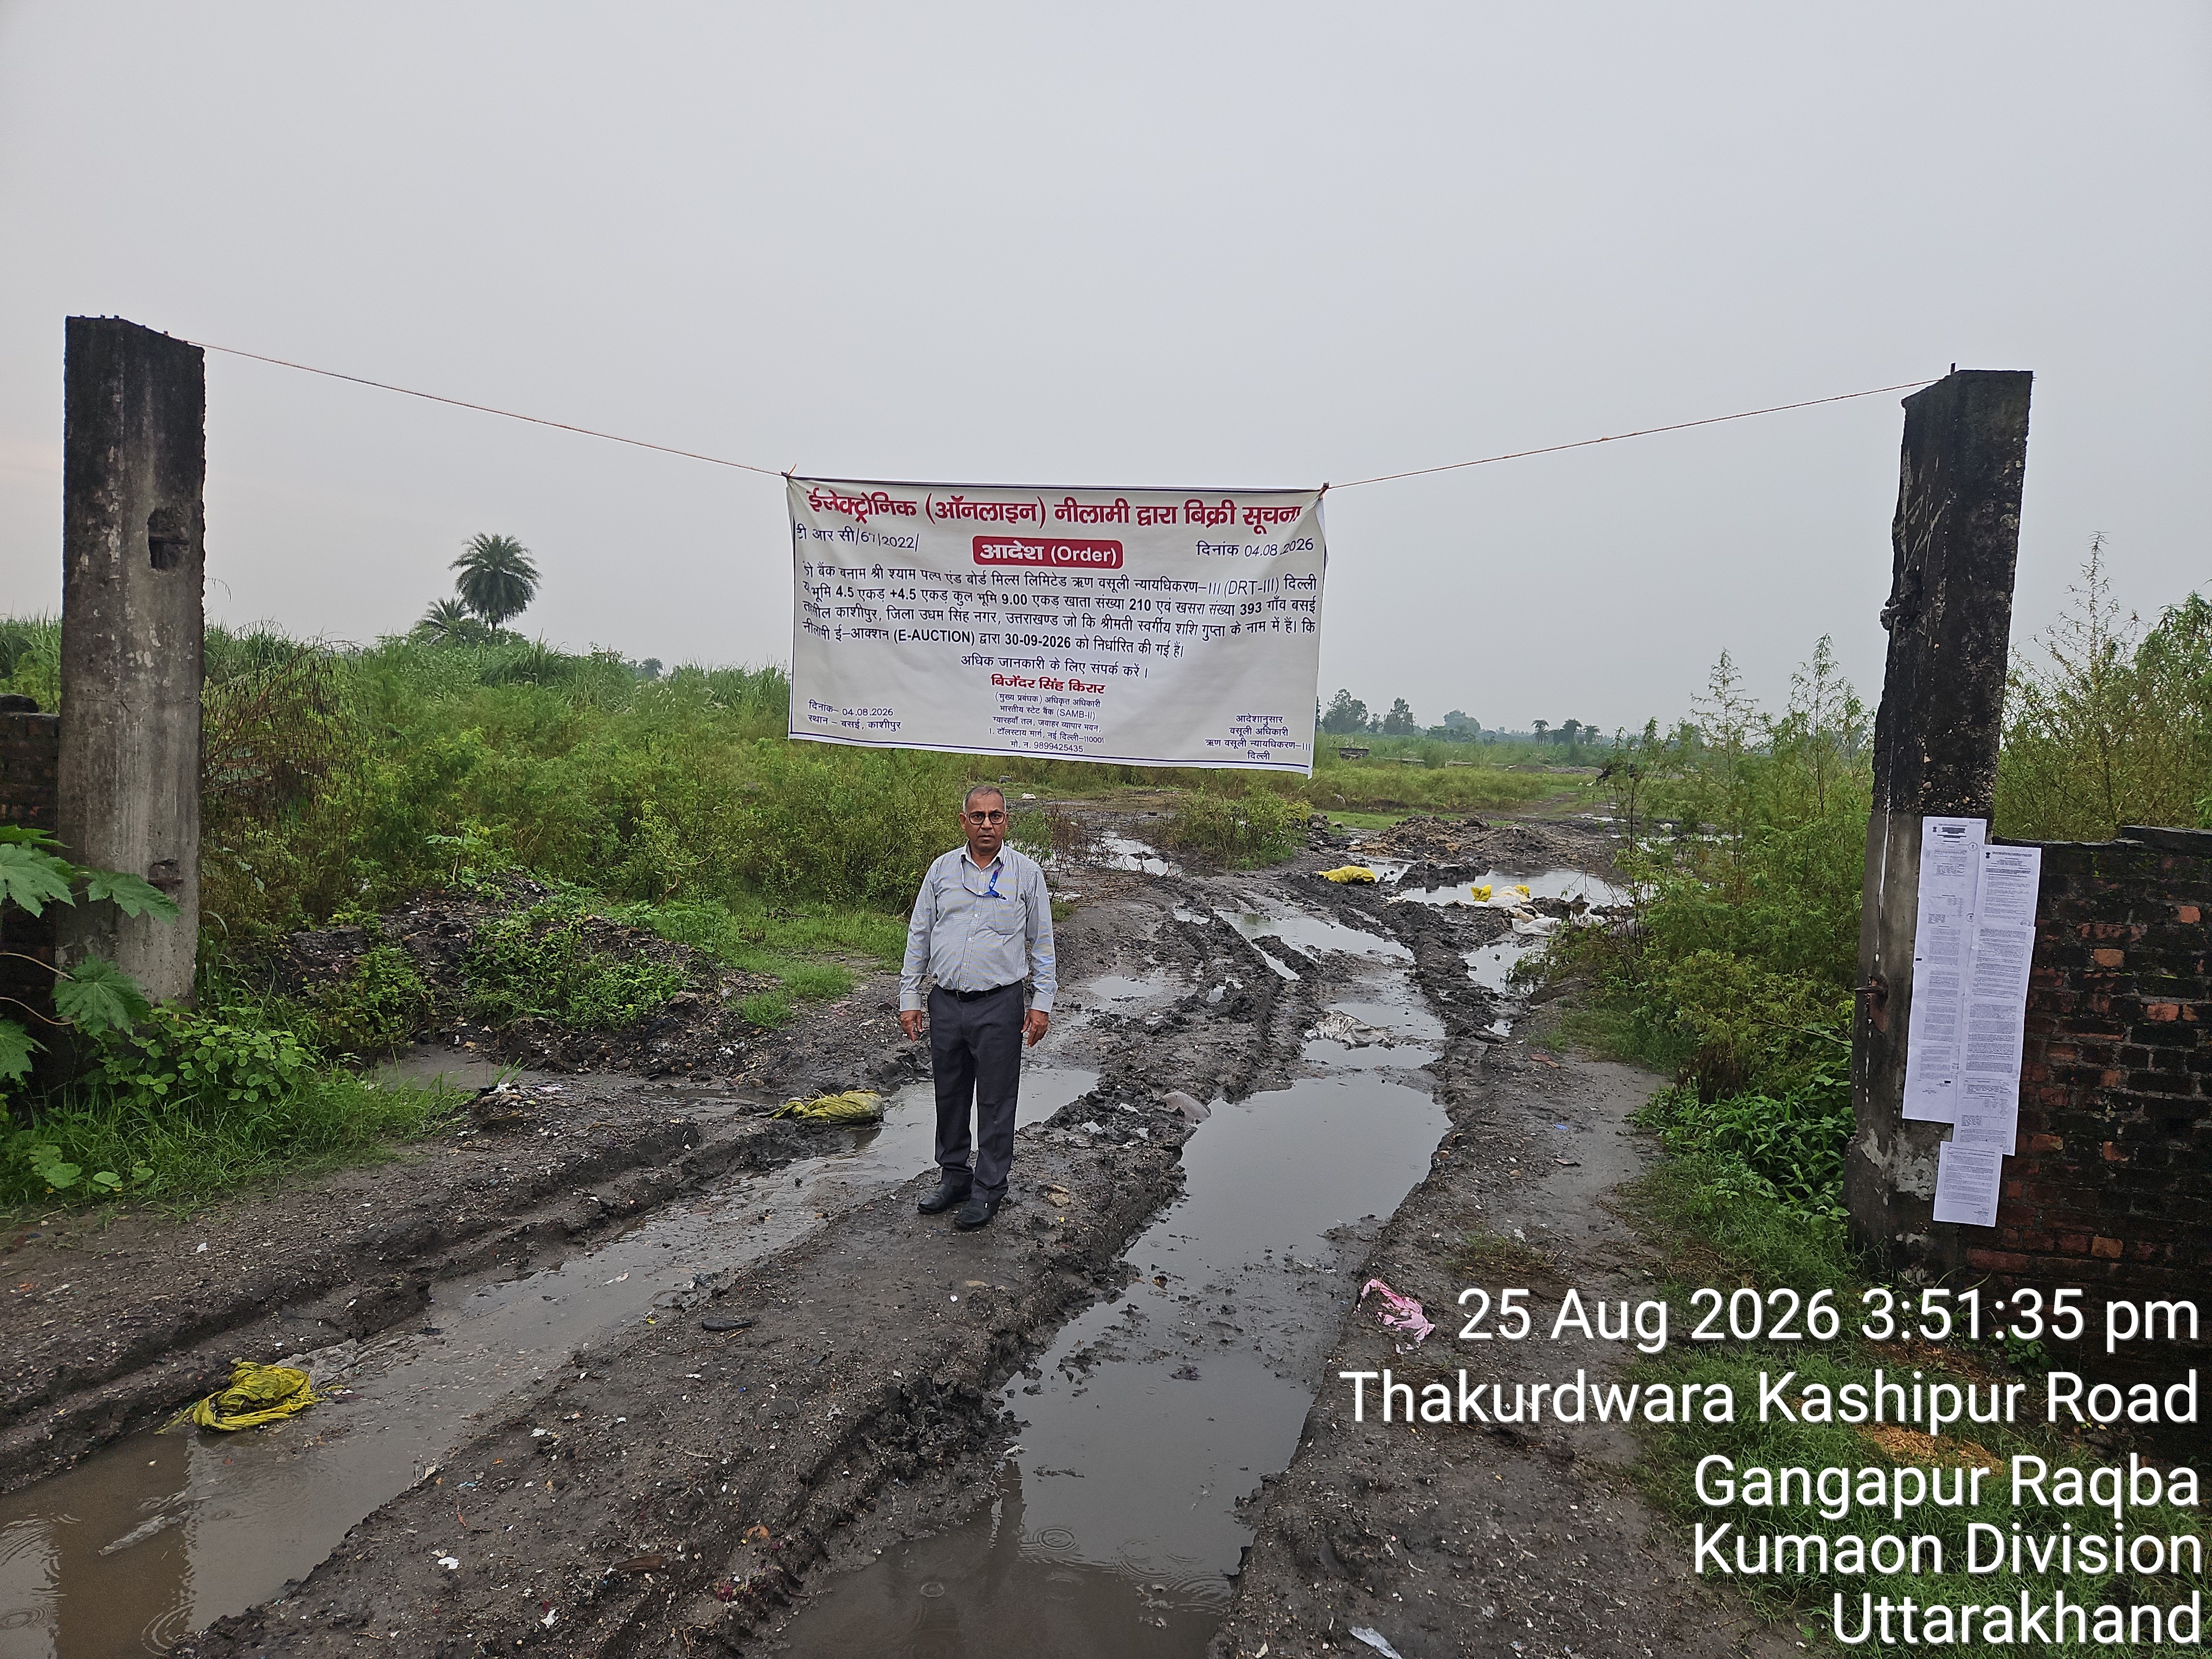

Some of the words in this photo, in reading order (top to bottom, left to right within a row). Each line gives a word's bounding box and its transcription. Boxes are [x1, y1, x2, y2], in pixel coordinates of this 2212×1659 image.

[925, 493, 1046, 529] (ऑनलाइन)
[1054, 497, 1130, 524] नीलामी
[1136, 506, 1178, 526] द्वारा
[1184, 499, 1237, 529] बिक्री
[1242, 506, 1303, 535] सूचना
[812, 529, 833, 541] आर
[980, 540, 1044, 560] आदेश
[1051, 546, 1116, 565] (Order)
[1195, 541, 1239, 556] दिनांक
[1245, 538, 1313, 557] 04.08.2026
[817, 561, 835, 577] बैंक
[838, 568, 866, 580] बनाम
[871, 564, 883, 579] श्री
[888, 569, 916, 580] श्याम
[920, 570, 941, 581] पल्प
[944, 570, 961, 584] एंड
[966, 570, 987, 585] बोर्ड
[991, 570, 1019, 586] मिल्स
[1024, 571, 1067, 587] लिमिटेड
[1071, 577, 1093, 588] ऋण
[1097, 574, 1129, 593] वसूली
[1224, 577, 1279, 600] (DRT-III)
[1283, 574, 1317, 590] दिल्ली
[811, 583, 831, 602] भूमि
[836, 586, 854, 597] 4.5
[857, 589, 885, 602] एकड़
[890, 588, 916, 600] +4.5
[920, 590, 948, 603] एकड़
[952, 591, 973, 606] कुल
[977, 590, 996, 607] भूमि
[1002, 594, 1027, 605] 9.00
[1032, 595, 1059, 608] एकड़
[1063, 596, 1090, 608] खाता
[1095, 594, 1124, 609] संख्या
[1129, 599, 1150, 611] 210
[1155, 597, 1171, 614] एवं
[1175, 602, 1205, 615] खसरा
[1209, 600, 1235, 616] संख्या
[1240, 602, 1262, 615] 393
[1290, 595, 1316, 614] बसई
[835, 603, 881, 622] काशीपुर,
[886, 605, 914, 620] जिला
[918, 610, 943, 621] उधम
[948, 607, 969, 623] सिंह
[973, 612, 1000, 625] नगर,
[1005, 613, 1059, 626] उत्तराखण्ड
[1063, 612, 1077, 627] जो
[1082, 613, 1096, 628] कि
[1101, 614, 1133, 631] श्रीमती
[1137, 617, 1171, 634] स्वर्गीय
[1202, 625, 1225, 641] गुप्ता
[1230, 621, 1242, 635] के
[1245, 621, 1266, 633] नाम
[1270, 616, 1279, 632] में
[1301, 617, 1315, 633] कि
[802, 618, 830, 640] नीलामी
[894, 629, 974, 646] (E-AUCTION)
[979, 633, 1000, 644] द्वारा
[1005, 633, 1070, 648] 30-09-2026
[1075, 634, 1089, 650] को
[1093, 635, 1134, 653] निर्धारित
[1137, 639, 1152, 654] की
[1155, 640, 1171, 658] गई
[961, 652, 994, 666] अधिक
[998, 656, 1045, 670] जानकारी
[1049, 657, 1060, 670] के
[1064, 658, 1086, 674] लिए
[1090, 661, 1118, 675] संपर्क
[1122, 663, 1140, 677] करें
[1038, 677, 1065, 691] सिंह
[1068, 679, 1105, 694] किरार
[995, 692, 1014, 703] (मुख्य
[1017, 693, 1042, 704] प्रबंधक)
[1045, 695, 1070, 706] अधिकृत
[1073, 697, 1101, 708] अधिकारी
[1000, 704, 1024, 713] भारतीय
[1026, 705, 1040, 714] स्टेट
[1043, 706, 1054, 715] बैंक
[1057, 709, 1095, 721] (SAMB-II)
[1236, 713, 1283, 726] आदेशानुसार
[808, 715, 828, 724] स्थान
[867, 718, 901, 732] काशीपुर
[1061, 722, 1082, 730] व्यापार
[1084, 724, 1101, 732] भवन,
[1229, 725, 1252, 738] वसूली
[1255, 726, 1288, 736] अधिकारी
[997, 727, 1026, 736] टॉलस्टाय
[1029, 729, 1045, 738] मार्ग,
[1047, 730, 1057, 740] नई
[1011, 739, 1020, 748] मो.
[1034, 742, 1083, 752] 9899425435
[1224, 738, 1246, 750] वसूली
[1247, 750, 1270, 760] दिल्ली
